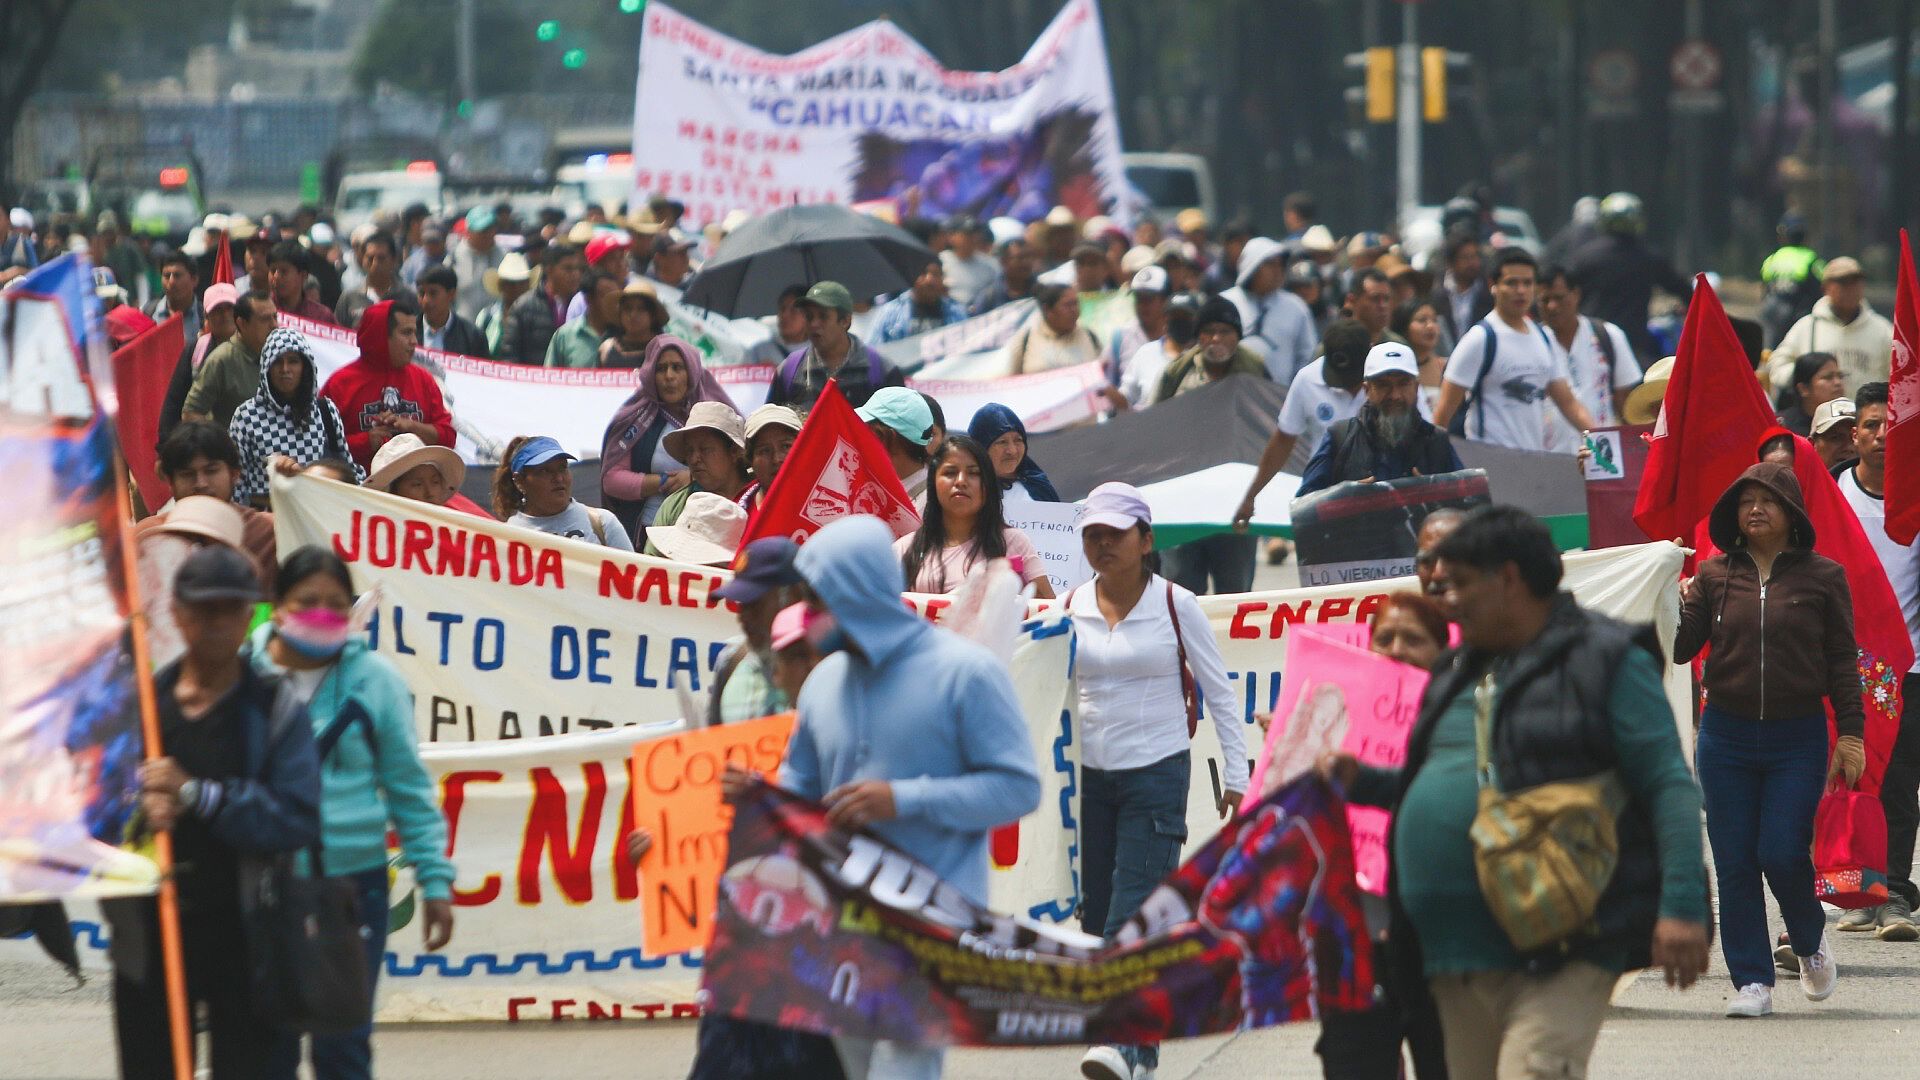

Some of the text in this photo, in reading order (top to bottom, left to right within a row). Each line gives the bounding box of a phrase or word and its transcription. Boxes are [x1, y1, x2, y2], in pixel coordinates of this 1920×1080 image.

[678, 119, 802, 153] MARCHA
[332, 509, 743, 613] JORNADA NACI
[1310, 570, 1330, 586] LO
[1338, 565, 1386, 582] VIERON
[550, 624, 612, 684] DE
[645, 732, 793, 796] Cons
